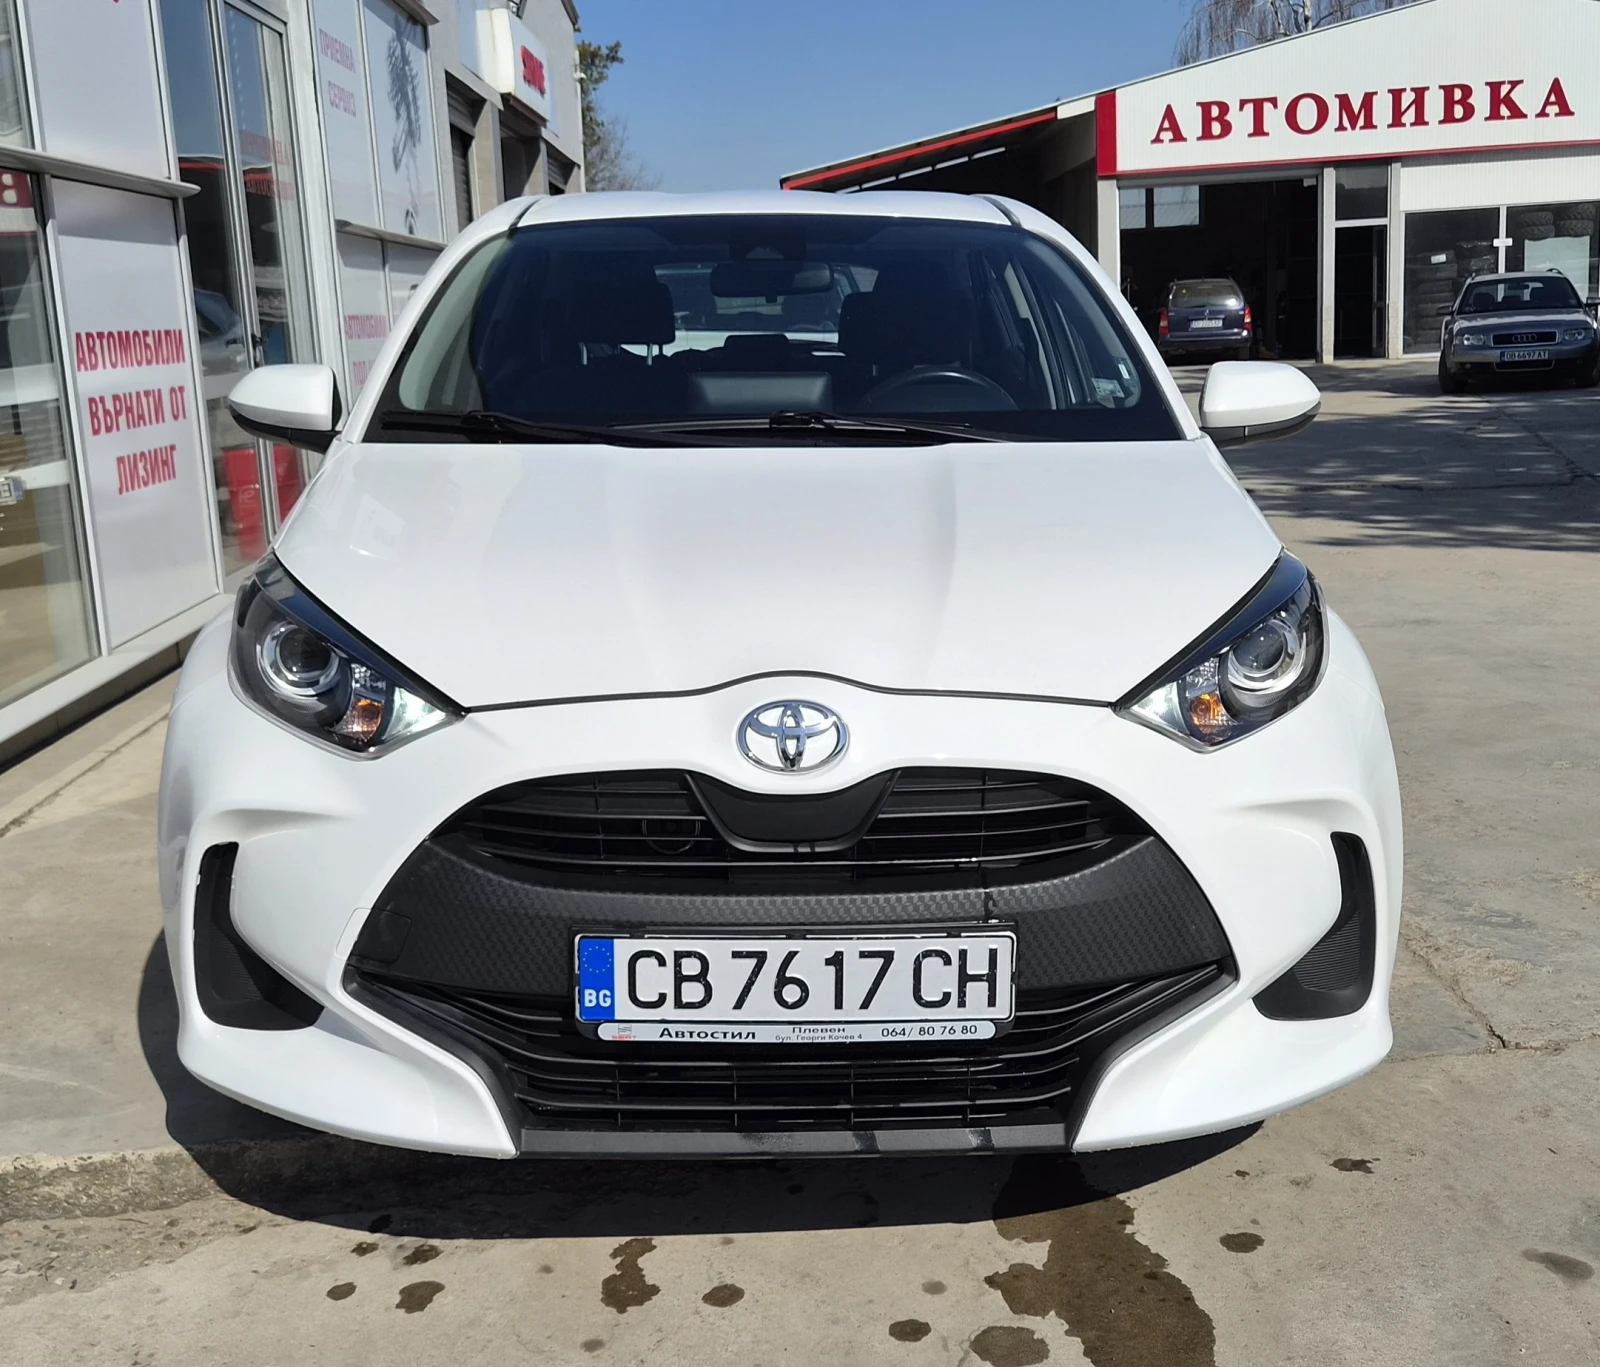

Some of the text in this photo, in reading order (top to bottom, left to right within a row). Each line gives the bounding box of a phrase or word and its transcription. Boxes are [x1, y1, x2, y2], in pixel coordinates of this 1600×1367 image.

[1150, 77, 1575, 145] АВТОМИВКА
[75, 329, 185, 373] АВТОМОБИЛИ
[87, 385, 187, 437] ВЪРНАТИ ОТ
[116, 444, 177, 496] ЛИЗИНГ
[584, 989, 612, 1008] BG
[627, 947, 998, 1010] CB 7617 CH
[659, 1027, 756, 1040] Автостил
[792, 1026, 846, 1034] Плевен
[918, 1026, 935, 1037] 80
[940, 1025, 957, 1036] 76
[961, 1024, 978, 1035] 80
